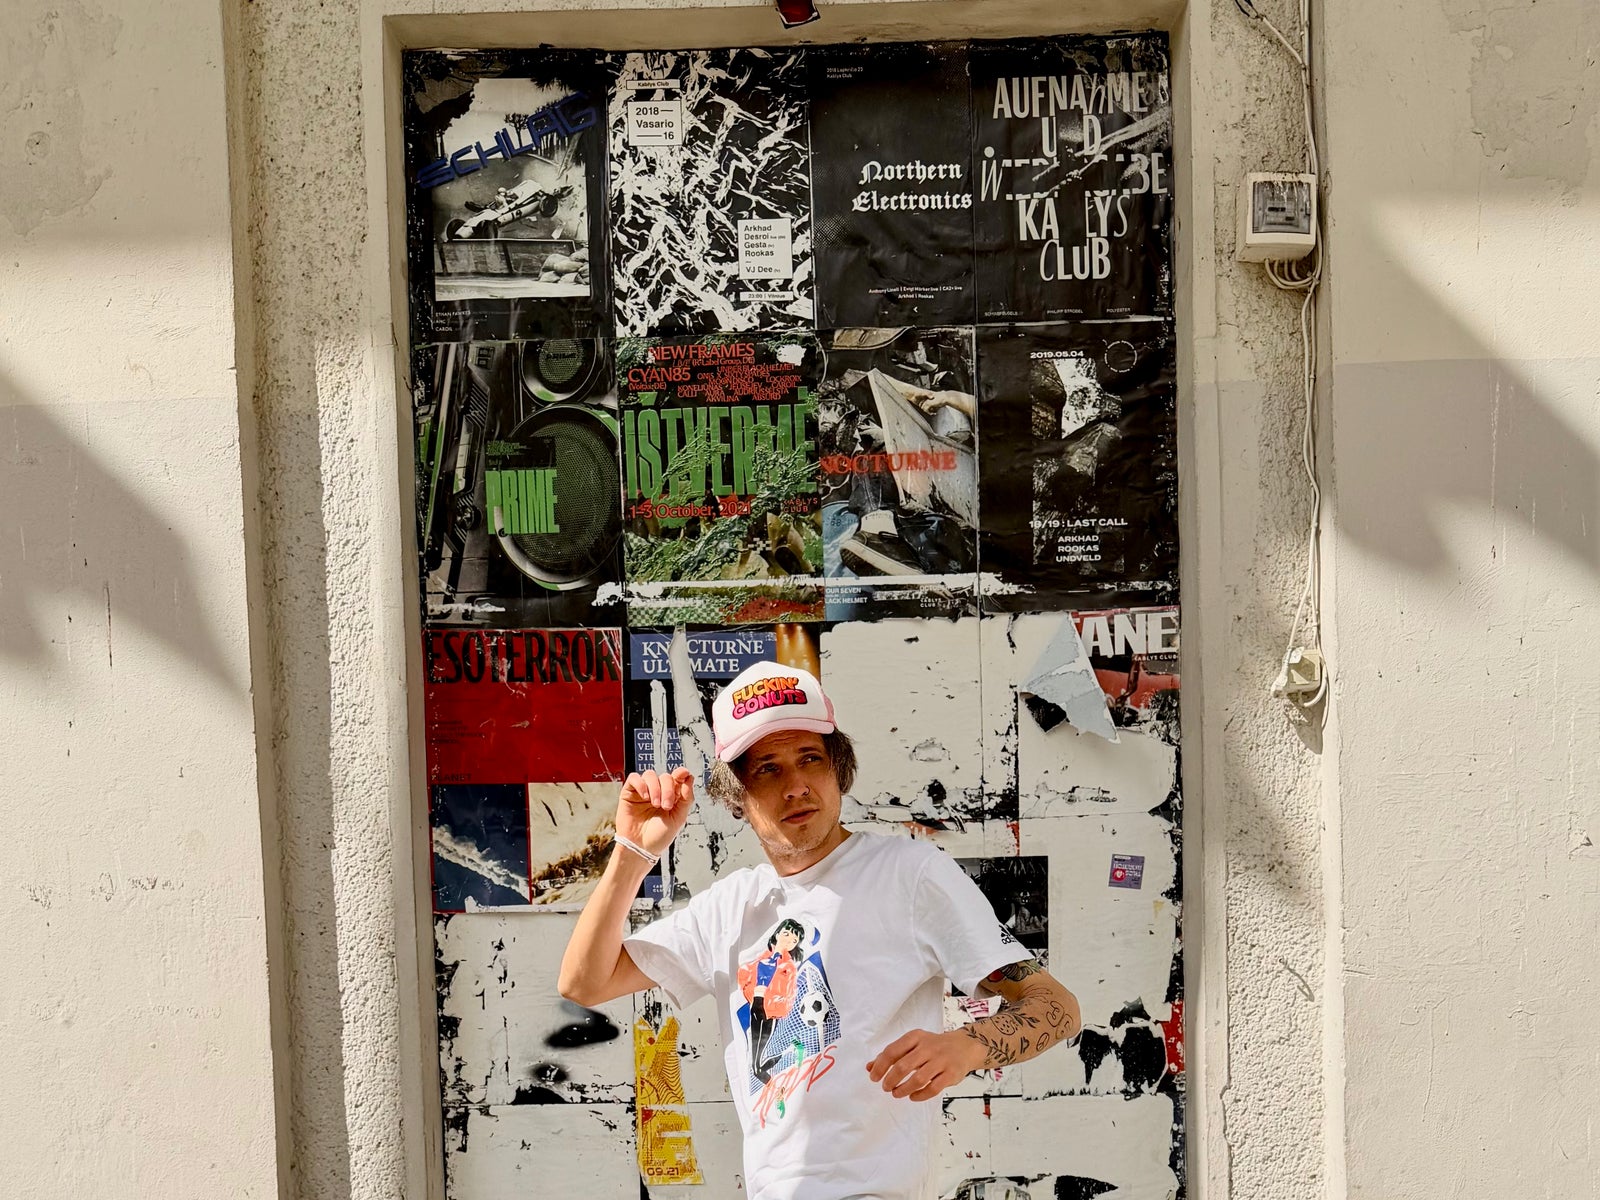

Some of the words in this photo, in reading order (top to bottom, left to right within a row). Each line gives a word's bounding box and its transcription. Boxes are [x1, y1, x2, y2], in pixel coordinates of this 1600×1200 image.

[636, 119, 674, 128] Vasario
[417, 91, 598, 189] SCHLAG
[1042, 114, 1102, 158] UD
[858, 160, 963, 185] Northern
[852, 190, 973, 212] Electronics
[1019, 194, 1131, 241] KALYS
[744, 241, 767, 249] Gesta
[757, 265, 773, 273] Dee
[1040, 237, 1111, 282] CLUB
[689, 343, 755, 359] FRAMES
[1030, 350, 1085, 359] 2019.05.04
[628, 368, 691, 383] CYAN85
[820, 450, 958, 475] NOCTURNE
[485, 469, 560, 535] PRIME
[655, 503, 717, 519] October,
[719, 501, 751, 517] 2021
[1066, 519, 1097, 527] LAST
[1098, 518, 1128, 526] CALL
[1056, 554, 1102, 562] UNDVELD
[1057, 545, 1099, 553] ROOKAS
[1073, 611, 1180, 658] ANE
[642, 639, 764, 659] KNCTURNE
[733, 676, 799, 705] FUCKIN'
[646, 1166, 679, 1177] 09.21
